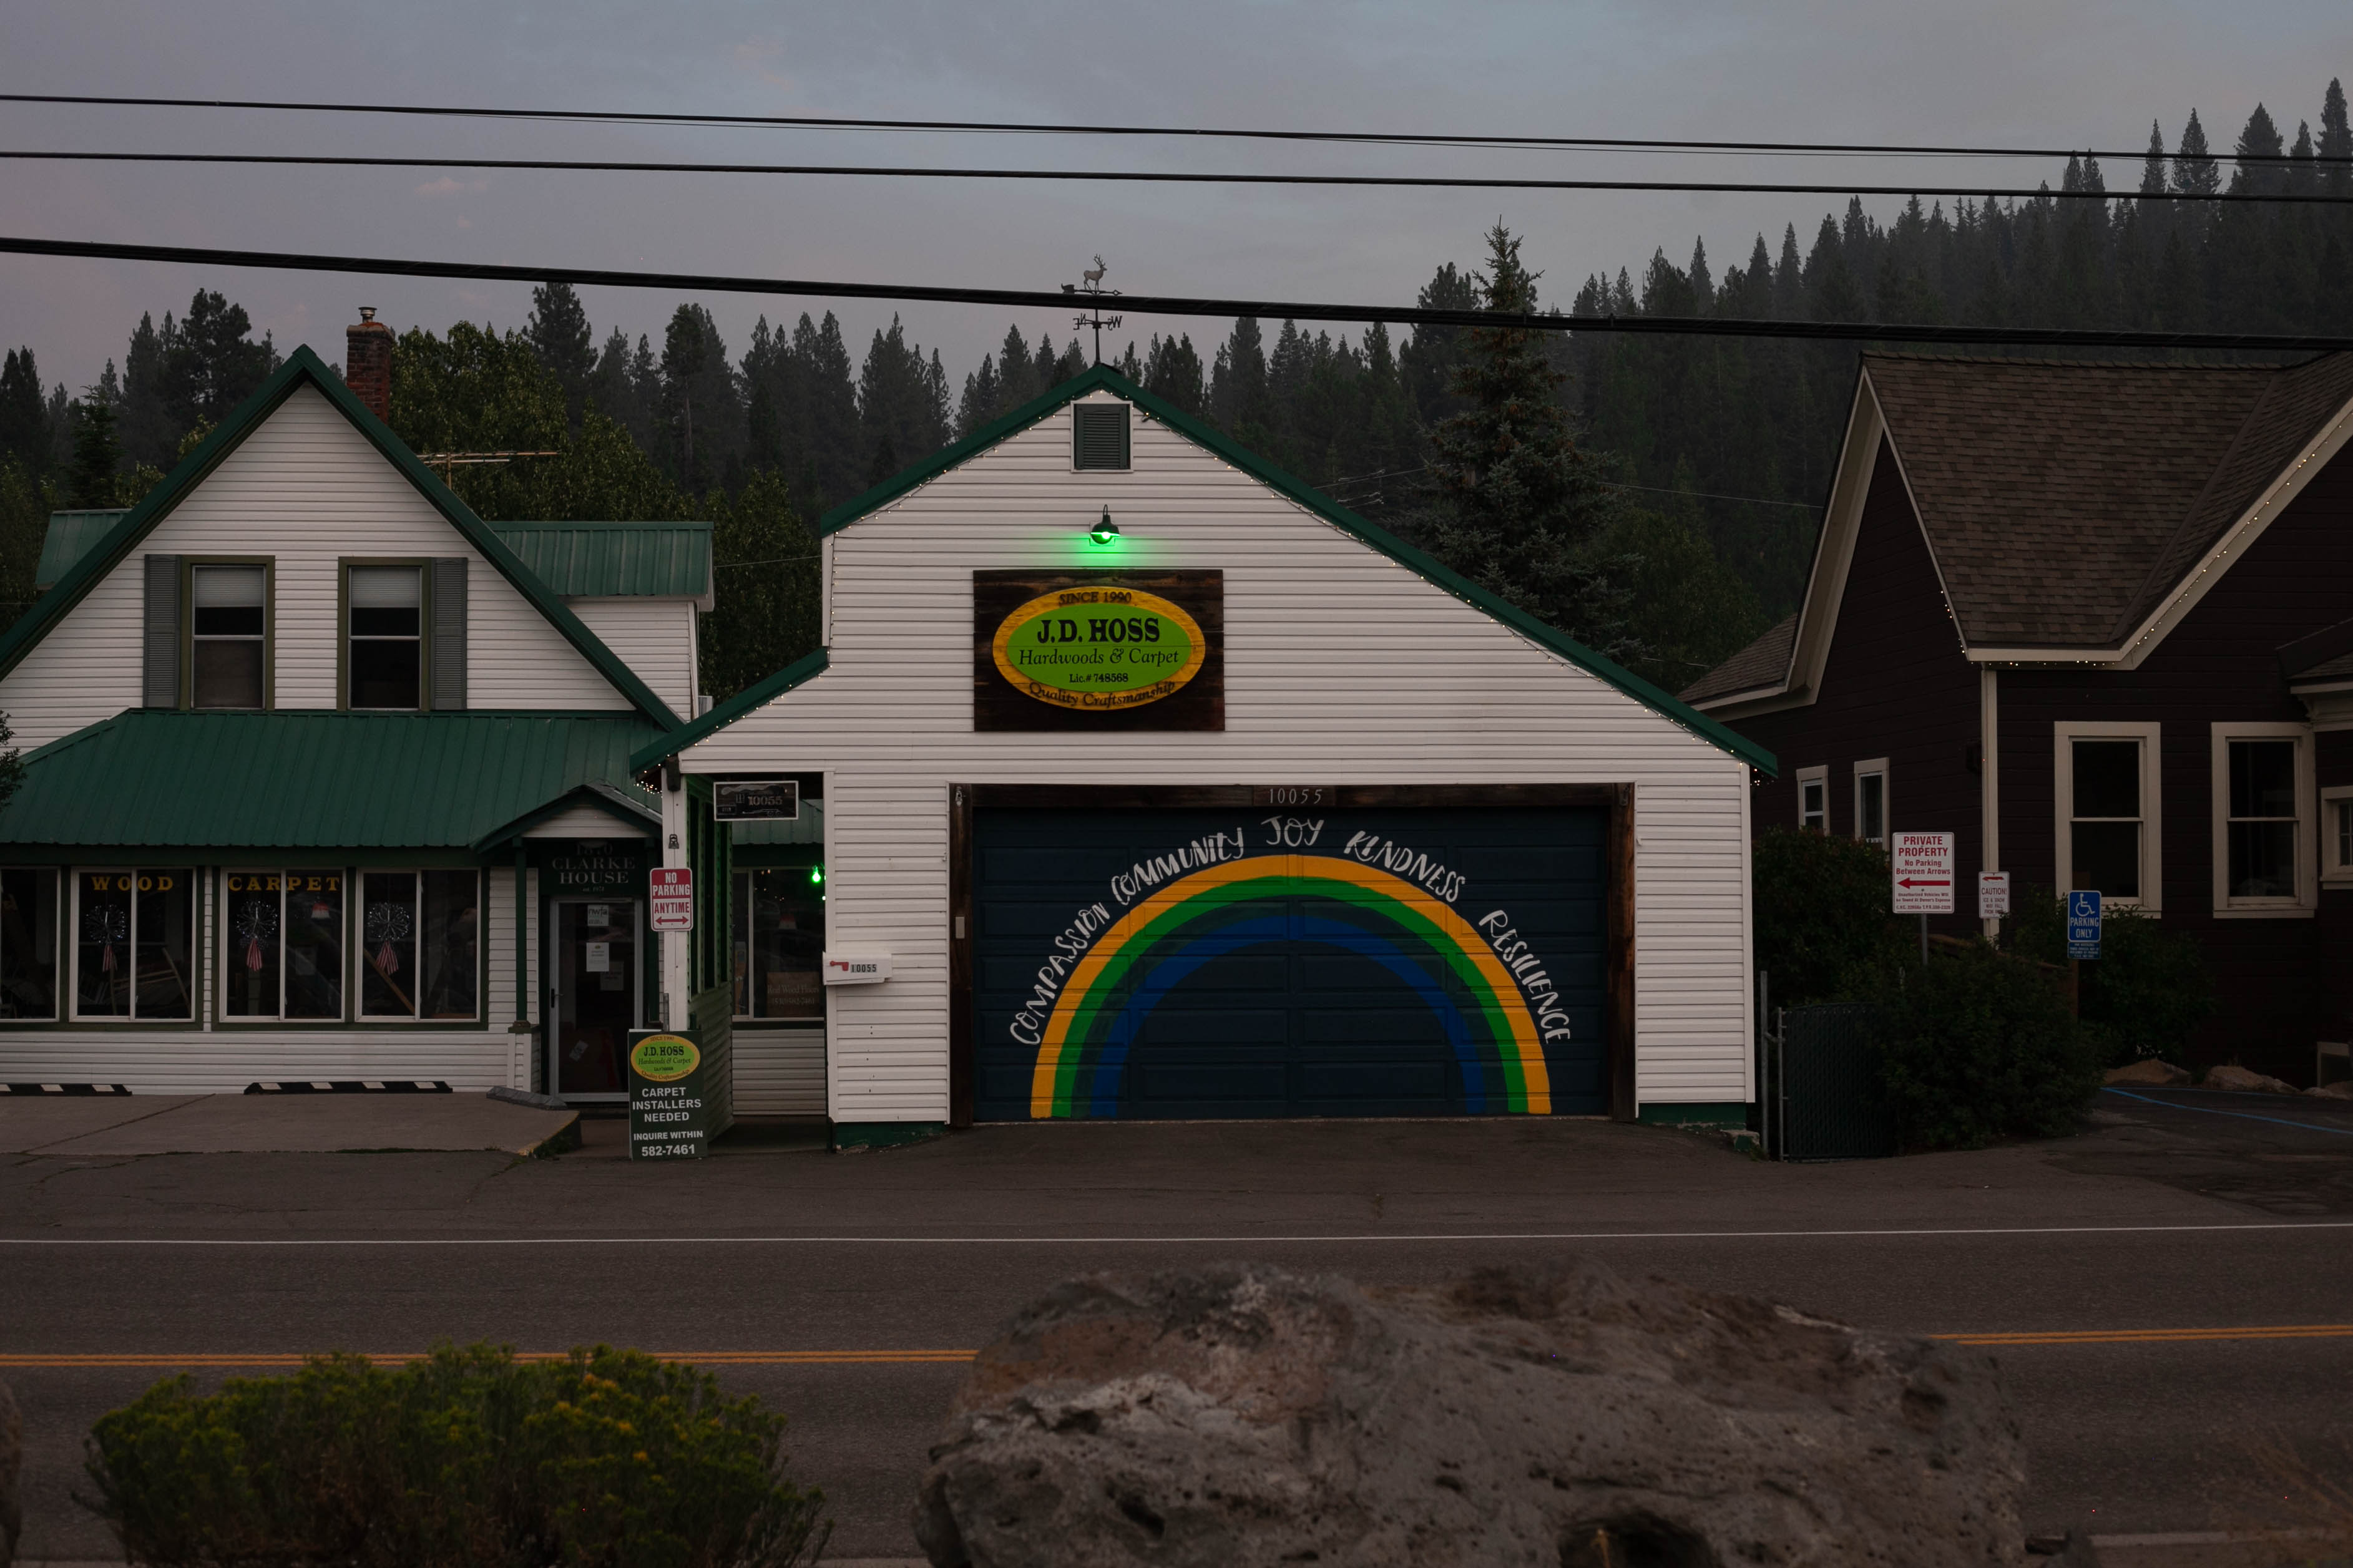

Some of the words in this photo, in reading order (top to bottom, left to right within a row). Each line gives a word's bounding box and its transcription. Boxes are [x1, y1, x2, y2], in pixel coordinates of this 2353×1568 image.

[1059, 592, 1098, 605] SINCE
[1103, 591, 1132, 604] 1990
[1037, 619, 1083, 643] J.D.
[1088, 618, 1160, 643] HOSS
[1019, 648, 1104, 666] Hardwoods
[1109, 648, 1123, 663] &
[1128, 648, 1179, 667] Carpet
[1029, 682, 1079, 706] Quality
[1083, 681, 1176, 706] Craftsmanship
[748, 795, 783, 807] 10055
[1268, 787, 1324, 805] 10055
[1904, 836, 1943, 845] PRIVATE
[1899, 847, 1948, 857] PROPERTY
[552, 857, 635, 870] CLARKE
[1915, 859, 1942, 867] Parking
[90, 875, 174, 892] WOOD
[228, 876, 341, 892] CARPET
[559, 872, 630, 885] HOUSE
[665, 872, 677, 884] NO
[652, 884, 690, 896] PARKING
[653, 902, 690, 914] ANYTIME
[2070, 917, 2099, 927] PARKING
[1009, 902, 1110, 1046] COMPASSION
[1260, 814, 1325, 847] JOY
[1343, 830, 1466, 903] KINDNESS
[1478, 909, 1571, 1045] RESILIENCE
[2076, 928, 2093, 938] ONLY
[851, 963, 877, 973] 10055
[644, 1046, 658, 1056] J.D.
[660, 1046, 684, 1056] HOSS
[642, 1087, 687, 1098] CARPET
[632, 1099, 702, 1111] INSTALLERS
[644, 1112, 690, 1122] NEEDED
[634, 1132, 668, 1141] INQUIRE
[670, 1130, 704, 1139] WITHIN
[641, 1144, 695, 1157] 582-7461
